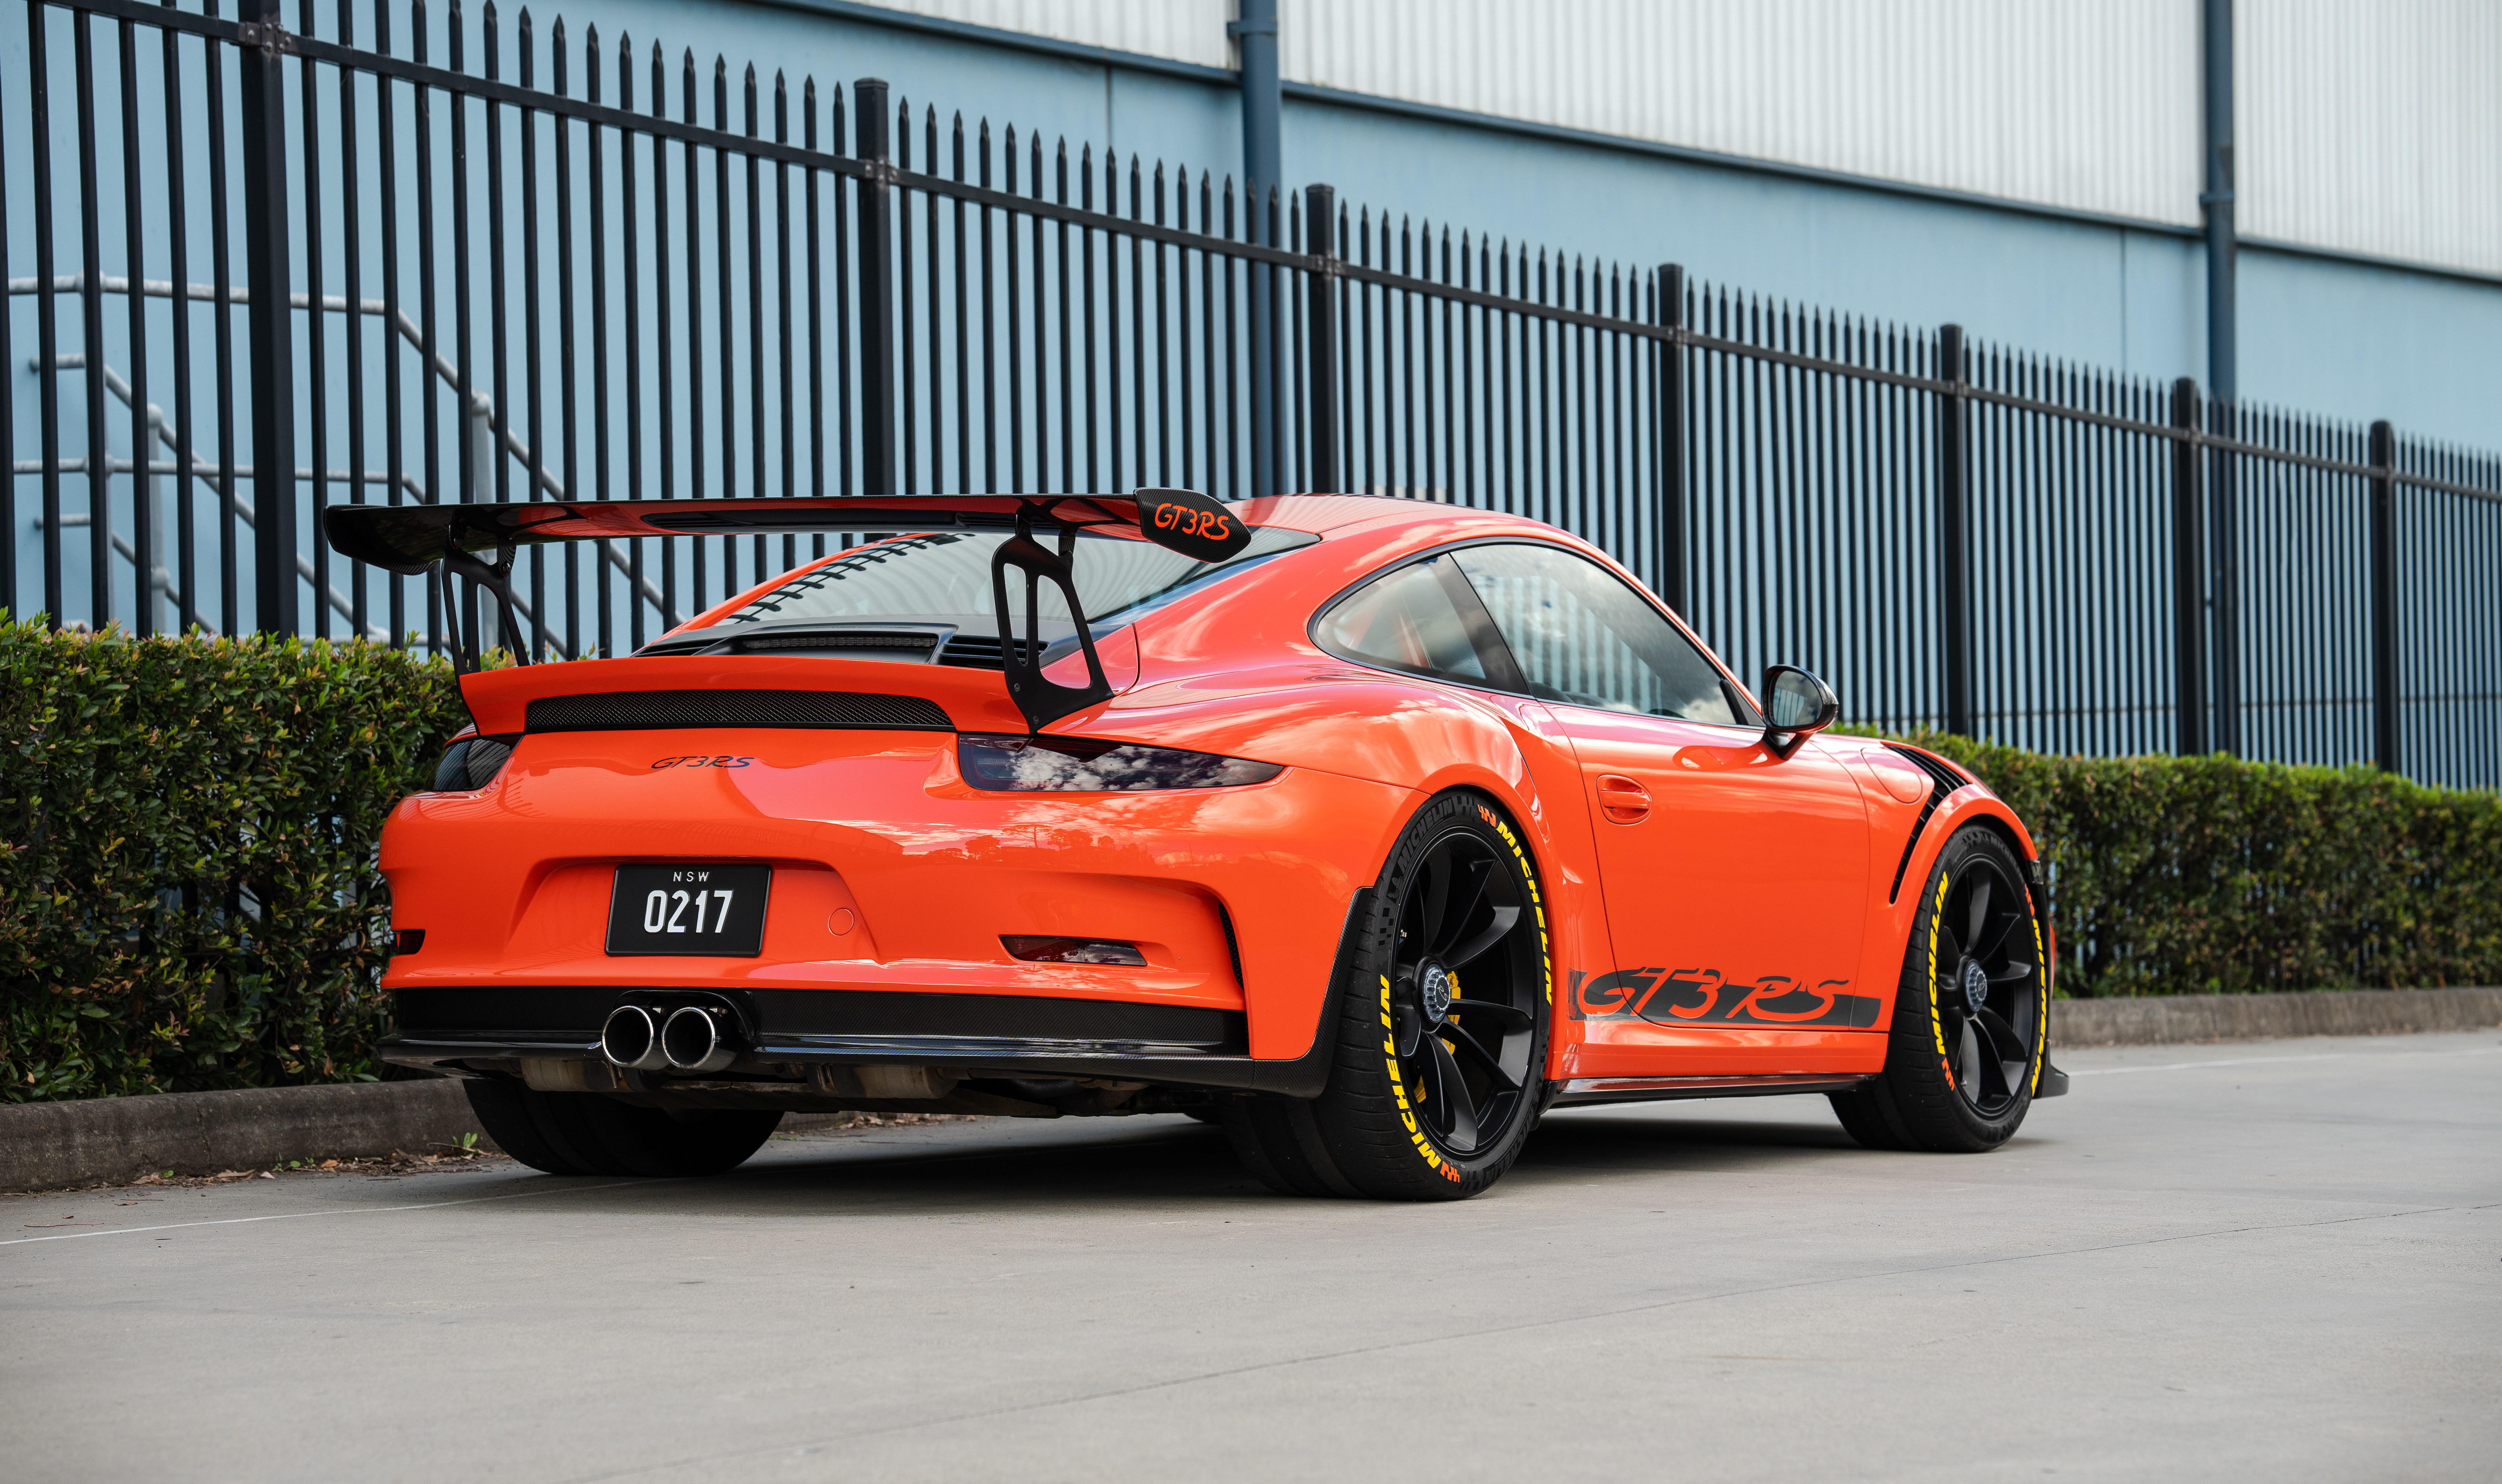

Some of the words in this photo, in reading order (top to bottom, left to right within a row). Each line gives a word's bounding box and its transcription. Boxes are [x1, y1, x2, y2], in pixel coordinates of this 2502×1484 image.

[673, 871, 709, 882] NSW
[1398, 798, 1453, 872] MICHELIN
[644, 890, 732, 933] 0217
[1495, 821, 1552, 1006] MICHELIN
[1929, 871, 1948, 1055] MICHELIN
[1437, 985, 1448, 1002] RS
[2031, 919, 2046, 1097] MICHELIN
[1380, 975, 1441, 1168] MICHELIN
